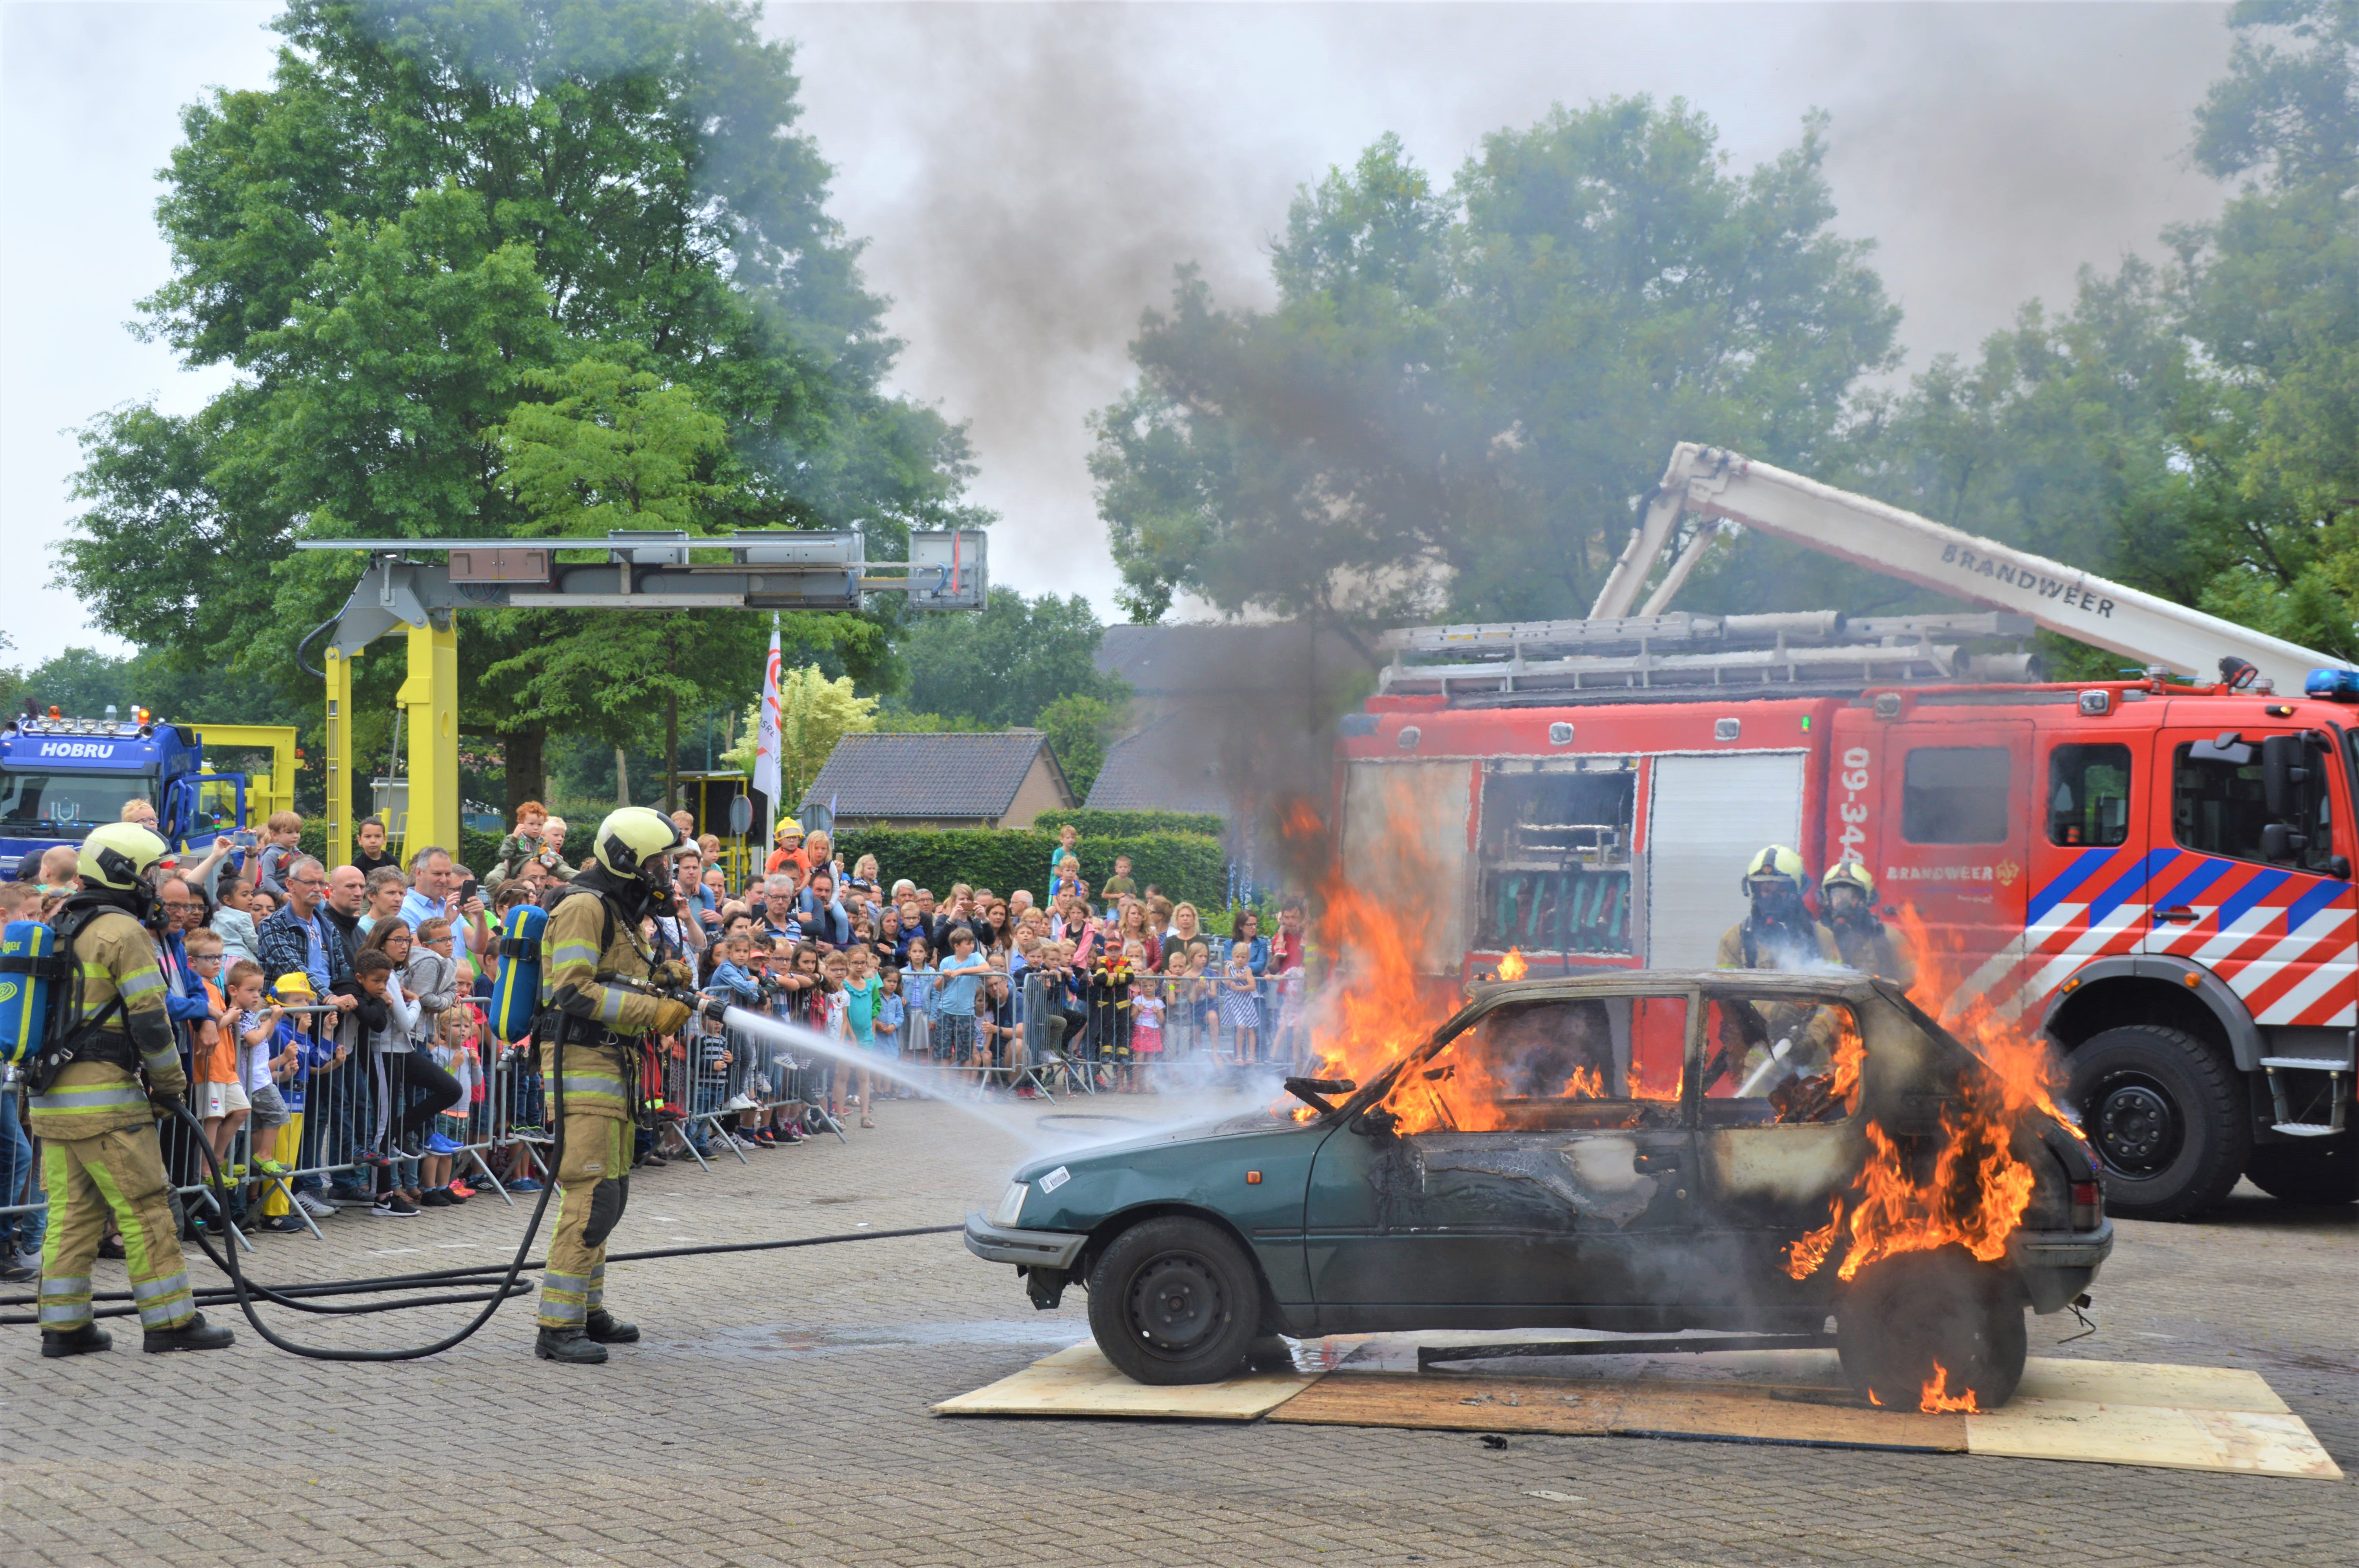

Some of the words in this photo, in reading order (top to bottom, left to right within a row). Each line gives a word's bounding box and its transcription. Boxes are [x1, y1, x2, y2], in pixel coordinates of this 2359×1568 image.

[1941, 544, 2115, 618] BRANDWEER
[40, 742, 114, 759] HOBRU
[1839, 747, 1870, 865] 09-344
[1886, 866, 1993, 880] BRANDWEER
